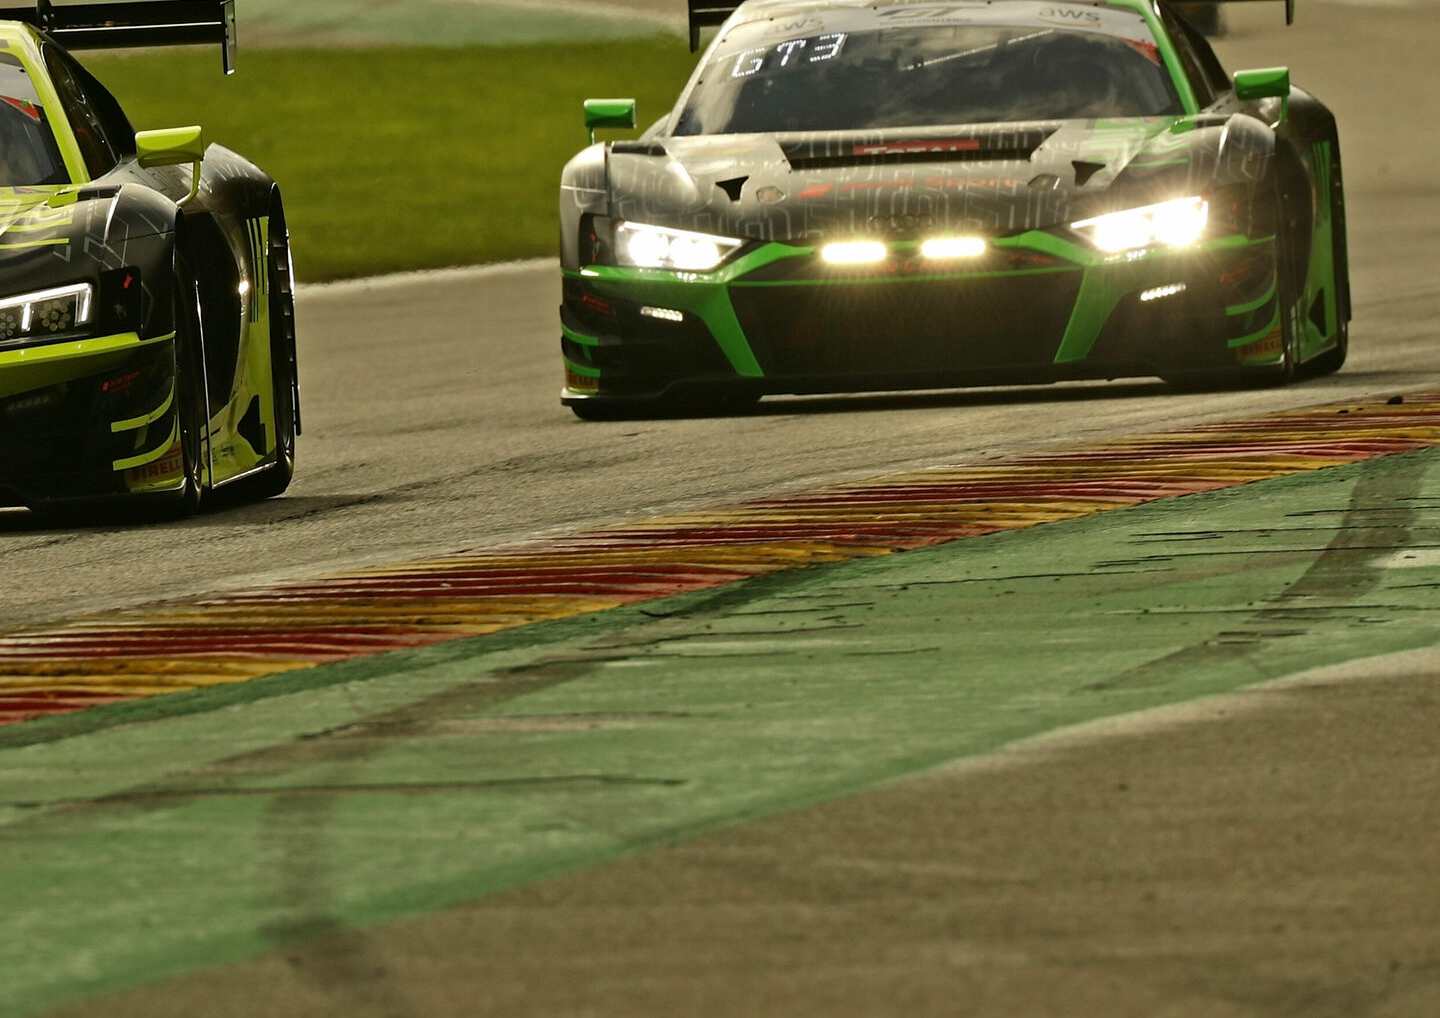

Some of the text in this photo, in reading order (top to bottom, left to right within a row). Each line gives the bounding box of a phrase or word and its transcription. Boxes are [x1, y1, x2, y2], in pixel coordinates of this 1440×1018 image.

[1039, 8, 1101, 22] aws
[732, 33, 845, 78] GT3
[841, 176, 1018, 191] Audi Sport
